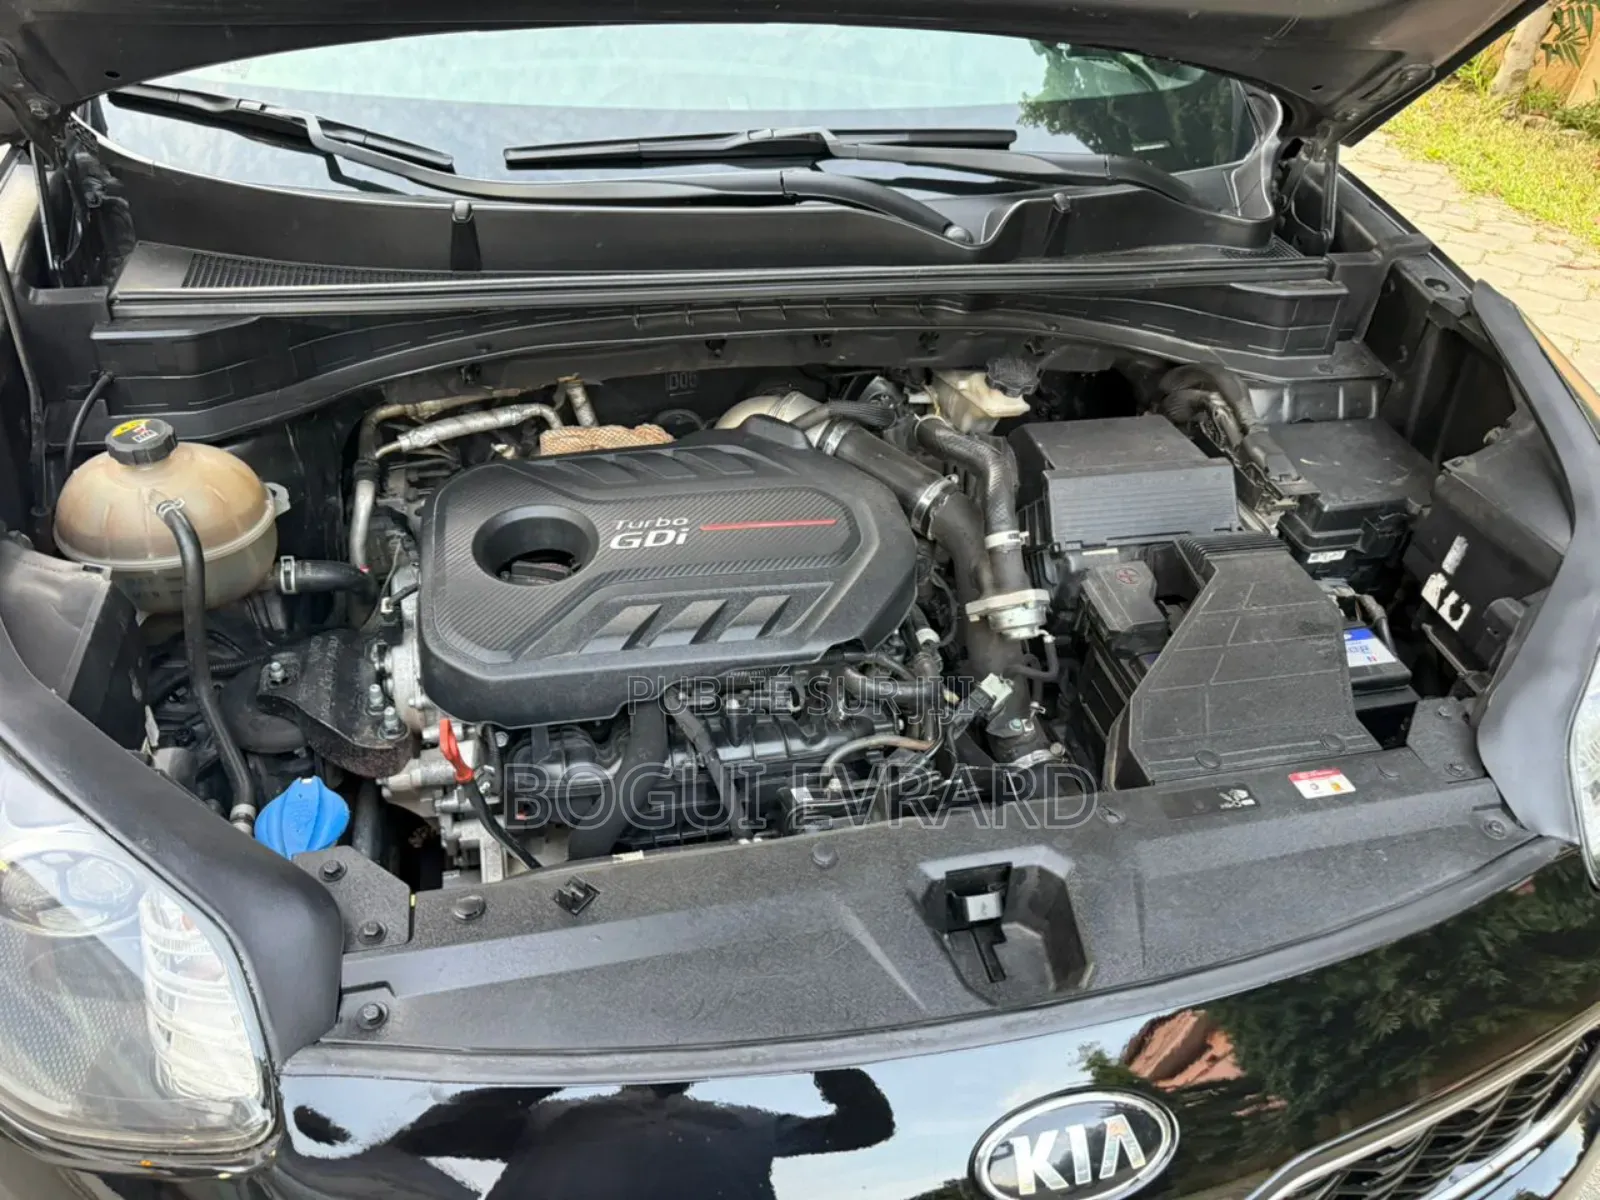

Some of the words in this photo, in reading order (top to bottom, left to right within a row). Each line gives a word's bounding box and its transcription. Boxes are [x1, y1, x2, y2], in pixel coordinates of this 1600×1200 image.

[615, 516, 689, 530] Turbo
[609, 527, 690, 550] GDi
[1009, 1113, 1146, 1196] KIA
